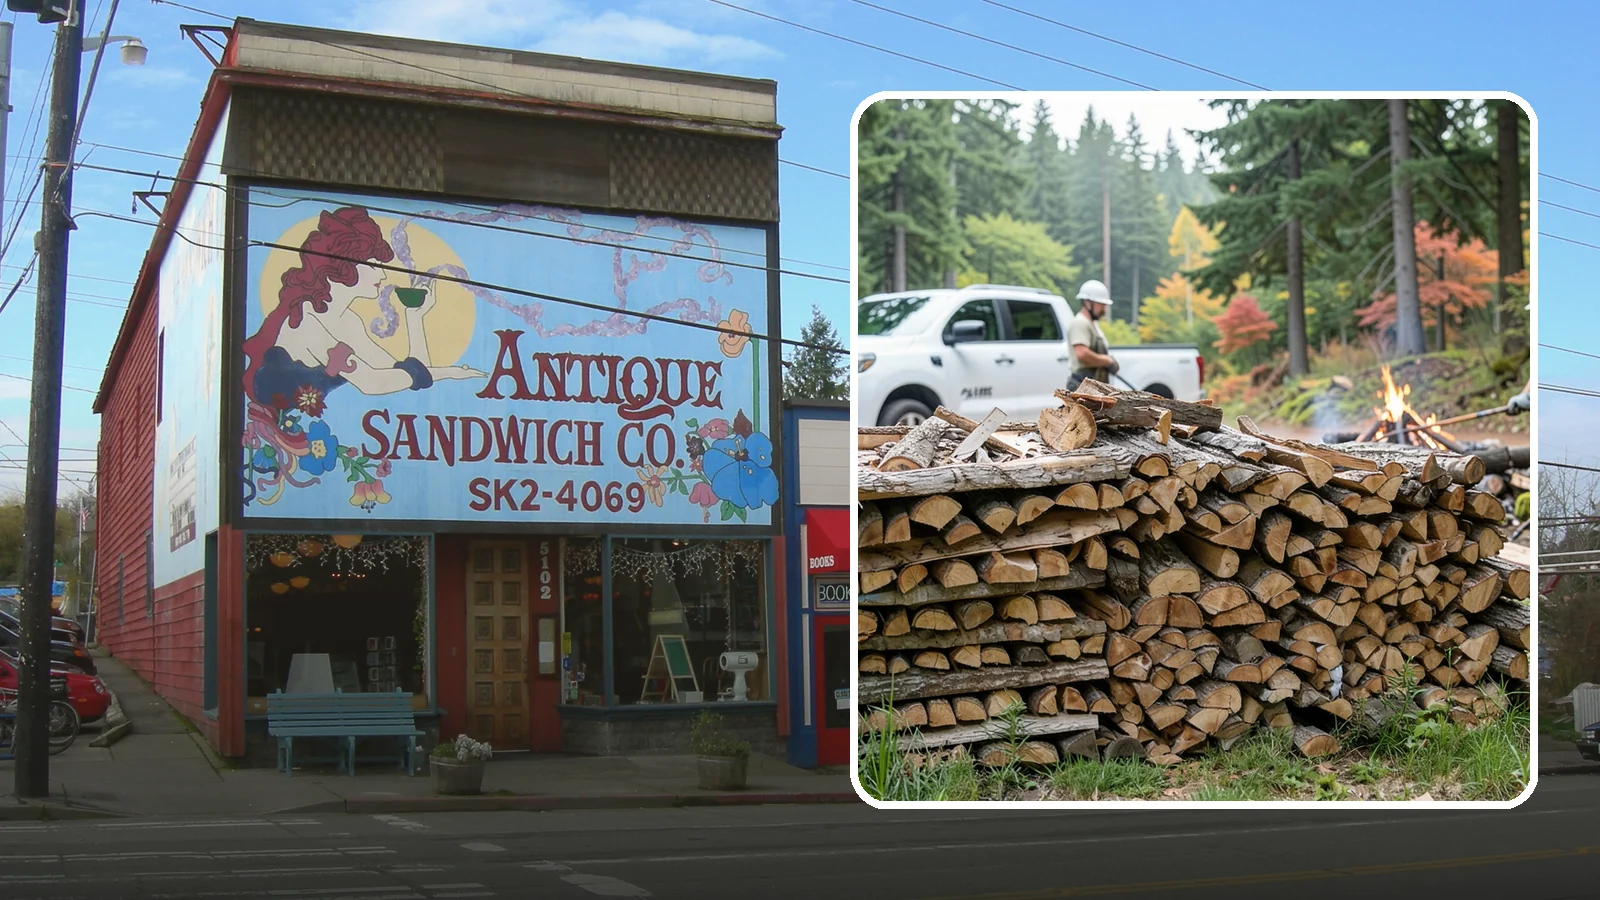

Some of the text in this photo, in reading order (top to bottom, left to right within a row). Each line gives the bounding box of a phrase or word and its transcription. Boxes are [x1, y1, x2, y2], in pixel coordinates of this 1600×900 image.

[476, 329, 723, 420] ANTIQUE
[361, 409, 685, 468] SANDWICH CO.
[468, 477, 646, 513] SK2-4069
[540, 542, 552, 600] 5102
[809, 555, 834, 569] BOOKS
